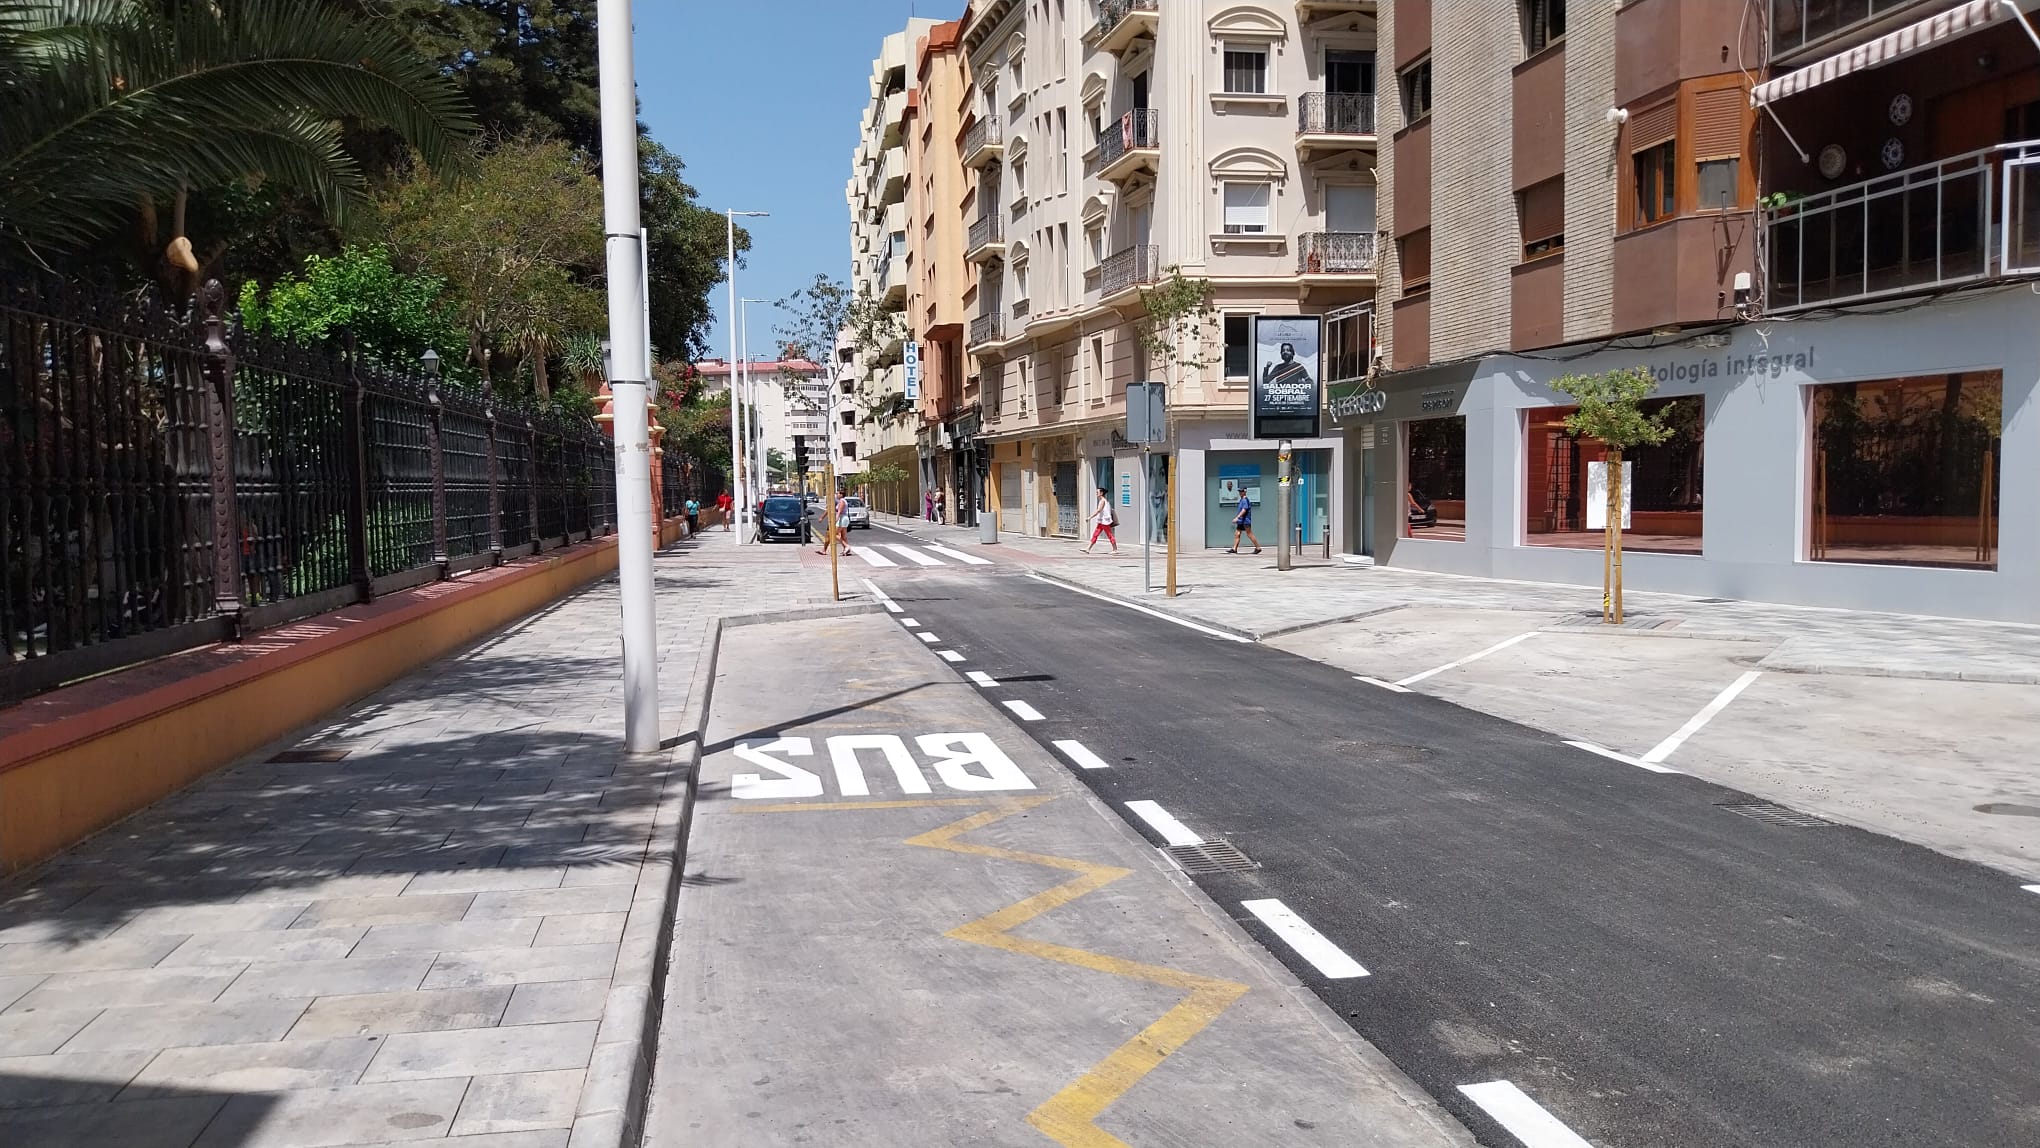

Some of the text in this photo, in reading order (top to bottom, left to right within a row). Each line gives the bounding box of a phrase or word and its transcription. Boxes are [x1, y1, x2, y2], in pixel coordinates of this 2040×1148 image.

[906, 343, 917, 398] HOTEL
[1726, 345, 1815, 379] integral
[1264, 394, 1310, 402] 27 SEPTIEMBRE
[732, 732, 1037, 799] BUS
